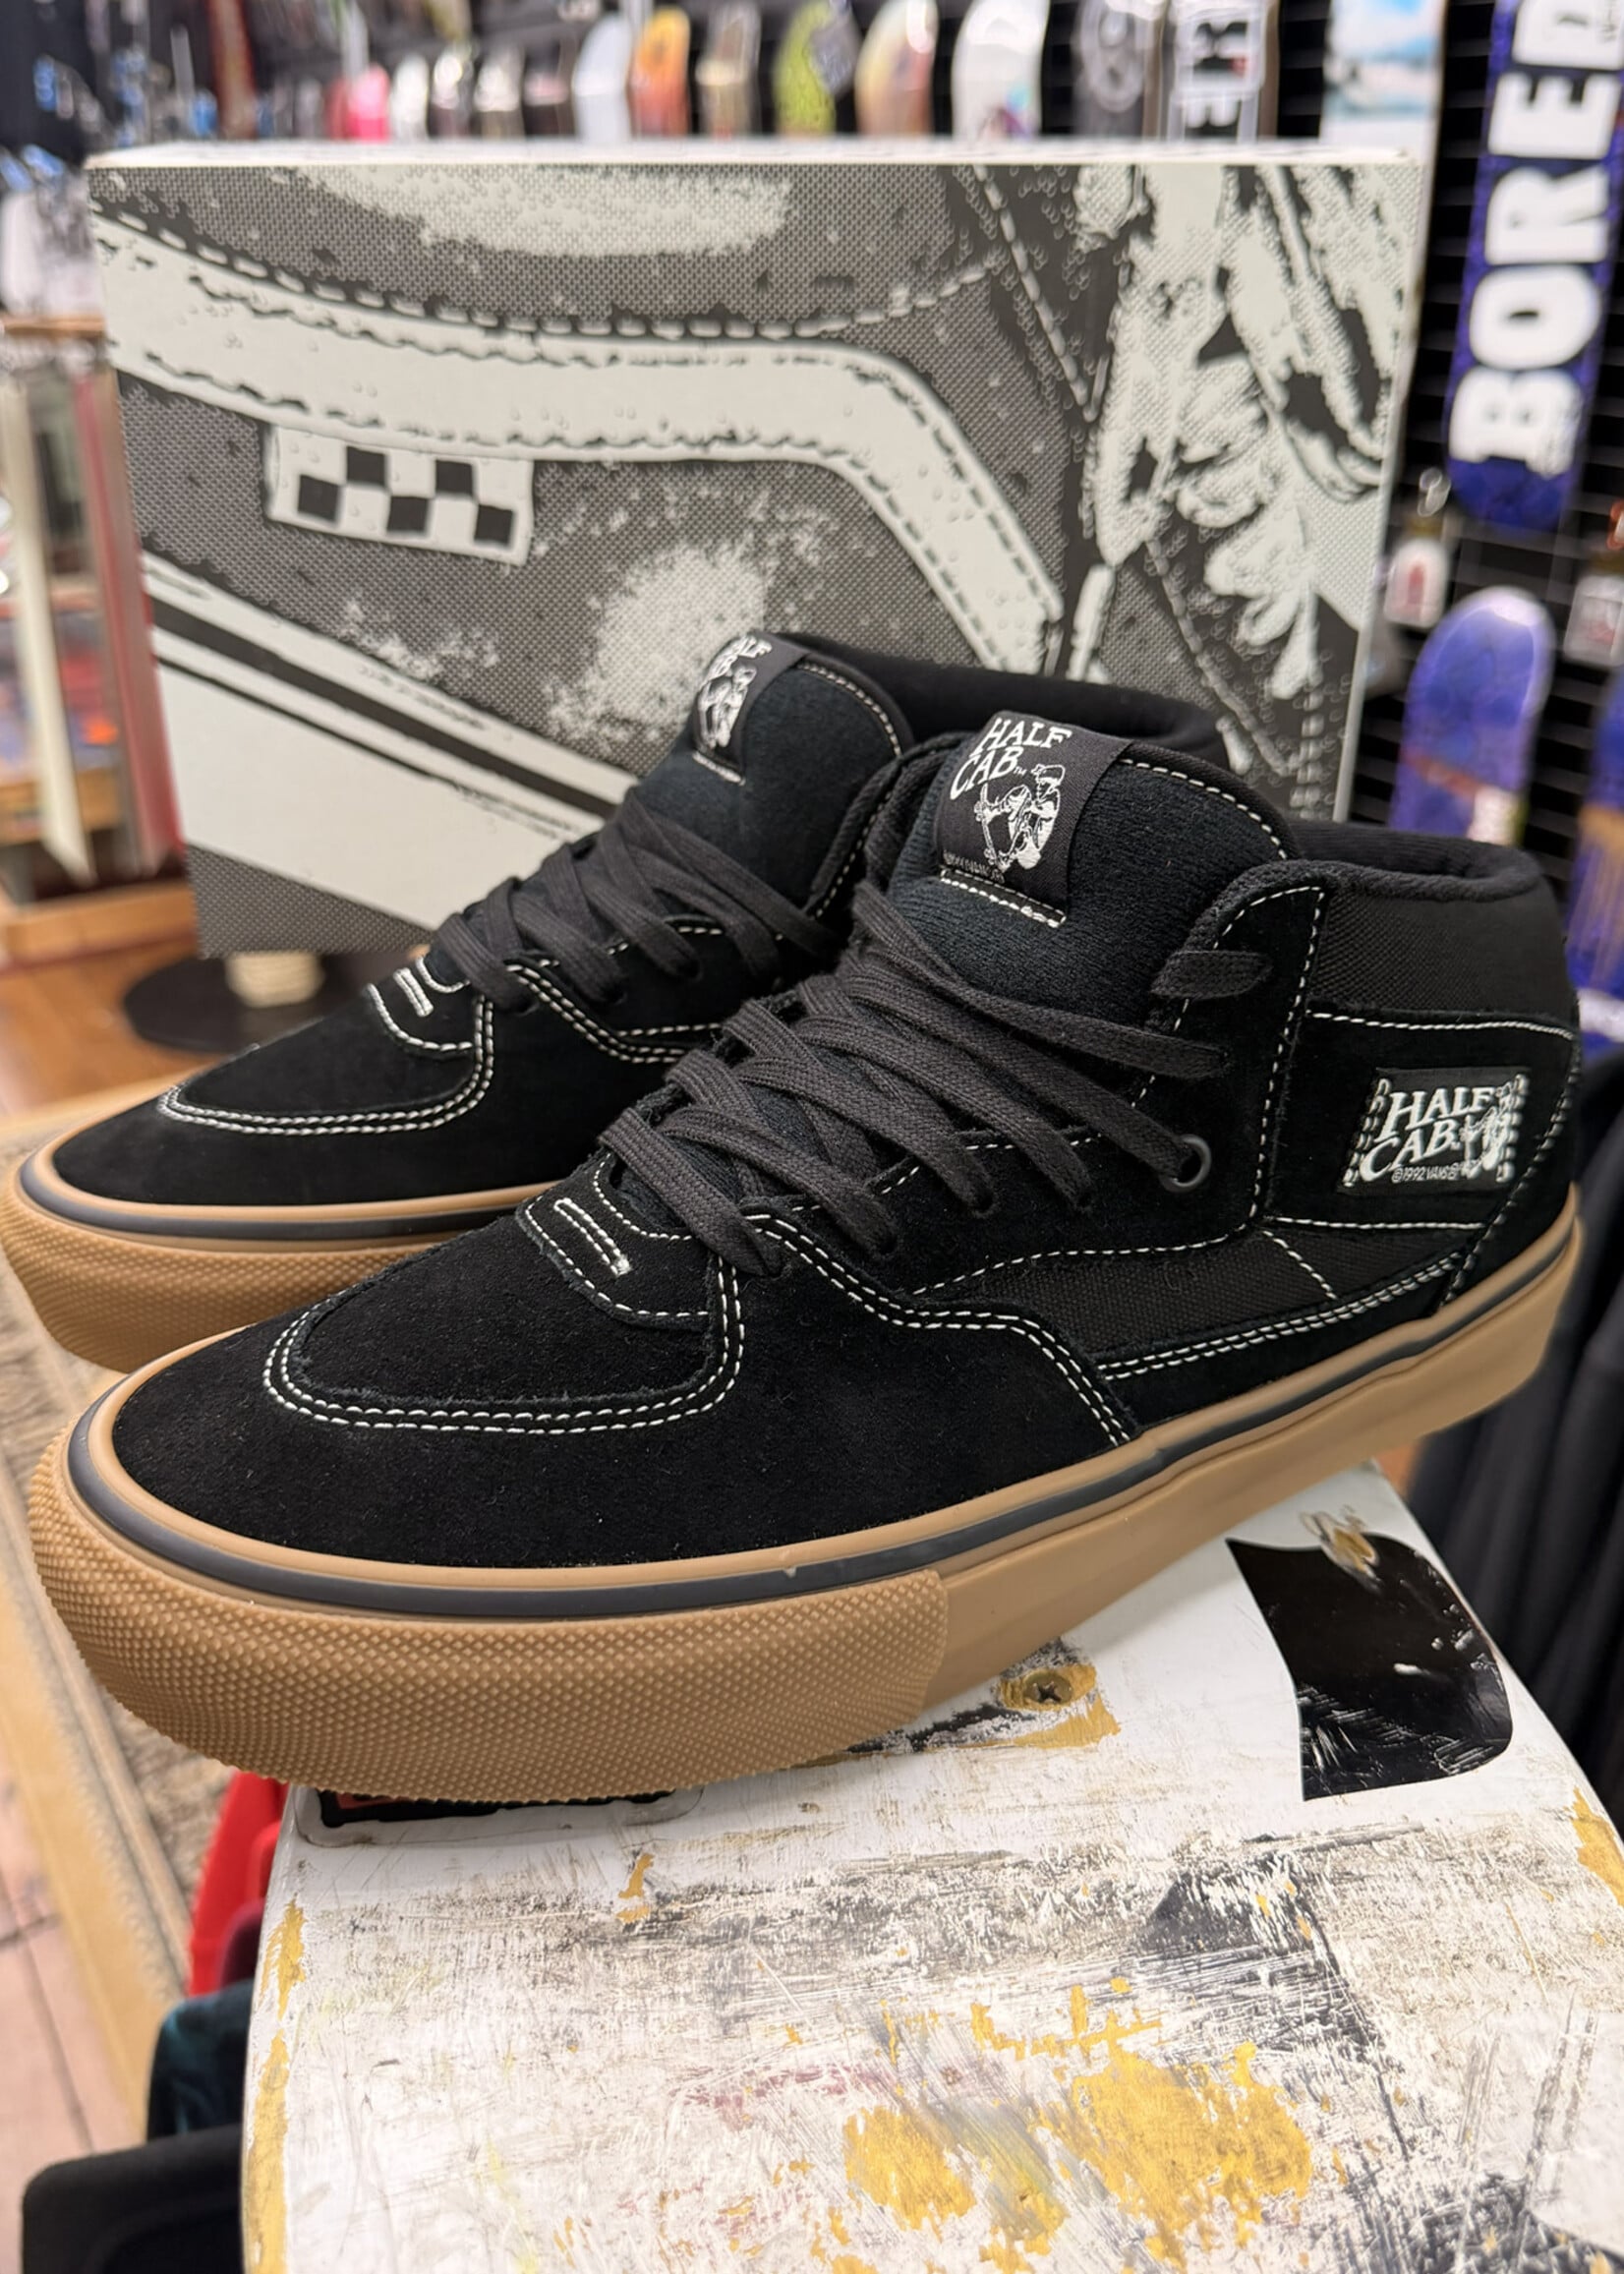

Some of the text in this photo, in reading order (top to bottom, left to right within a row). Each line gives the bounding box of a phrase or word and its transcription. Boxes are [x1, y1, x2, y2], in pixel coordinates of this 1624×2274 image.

[969, 717, 1073, 759] HALF
[950, 745, 1023, 800] CAB
[1373, 1086, 1496, 1143] HALF
[1359, 1118, 1460, 1182] CAB
